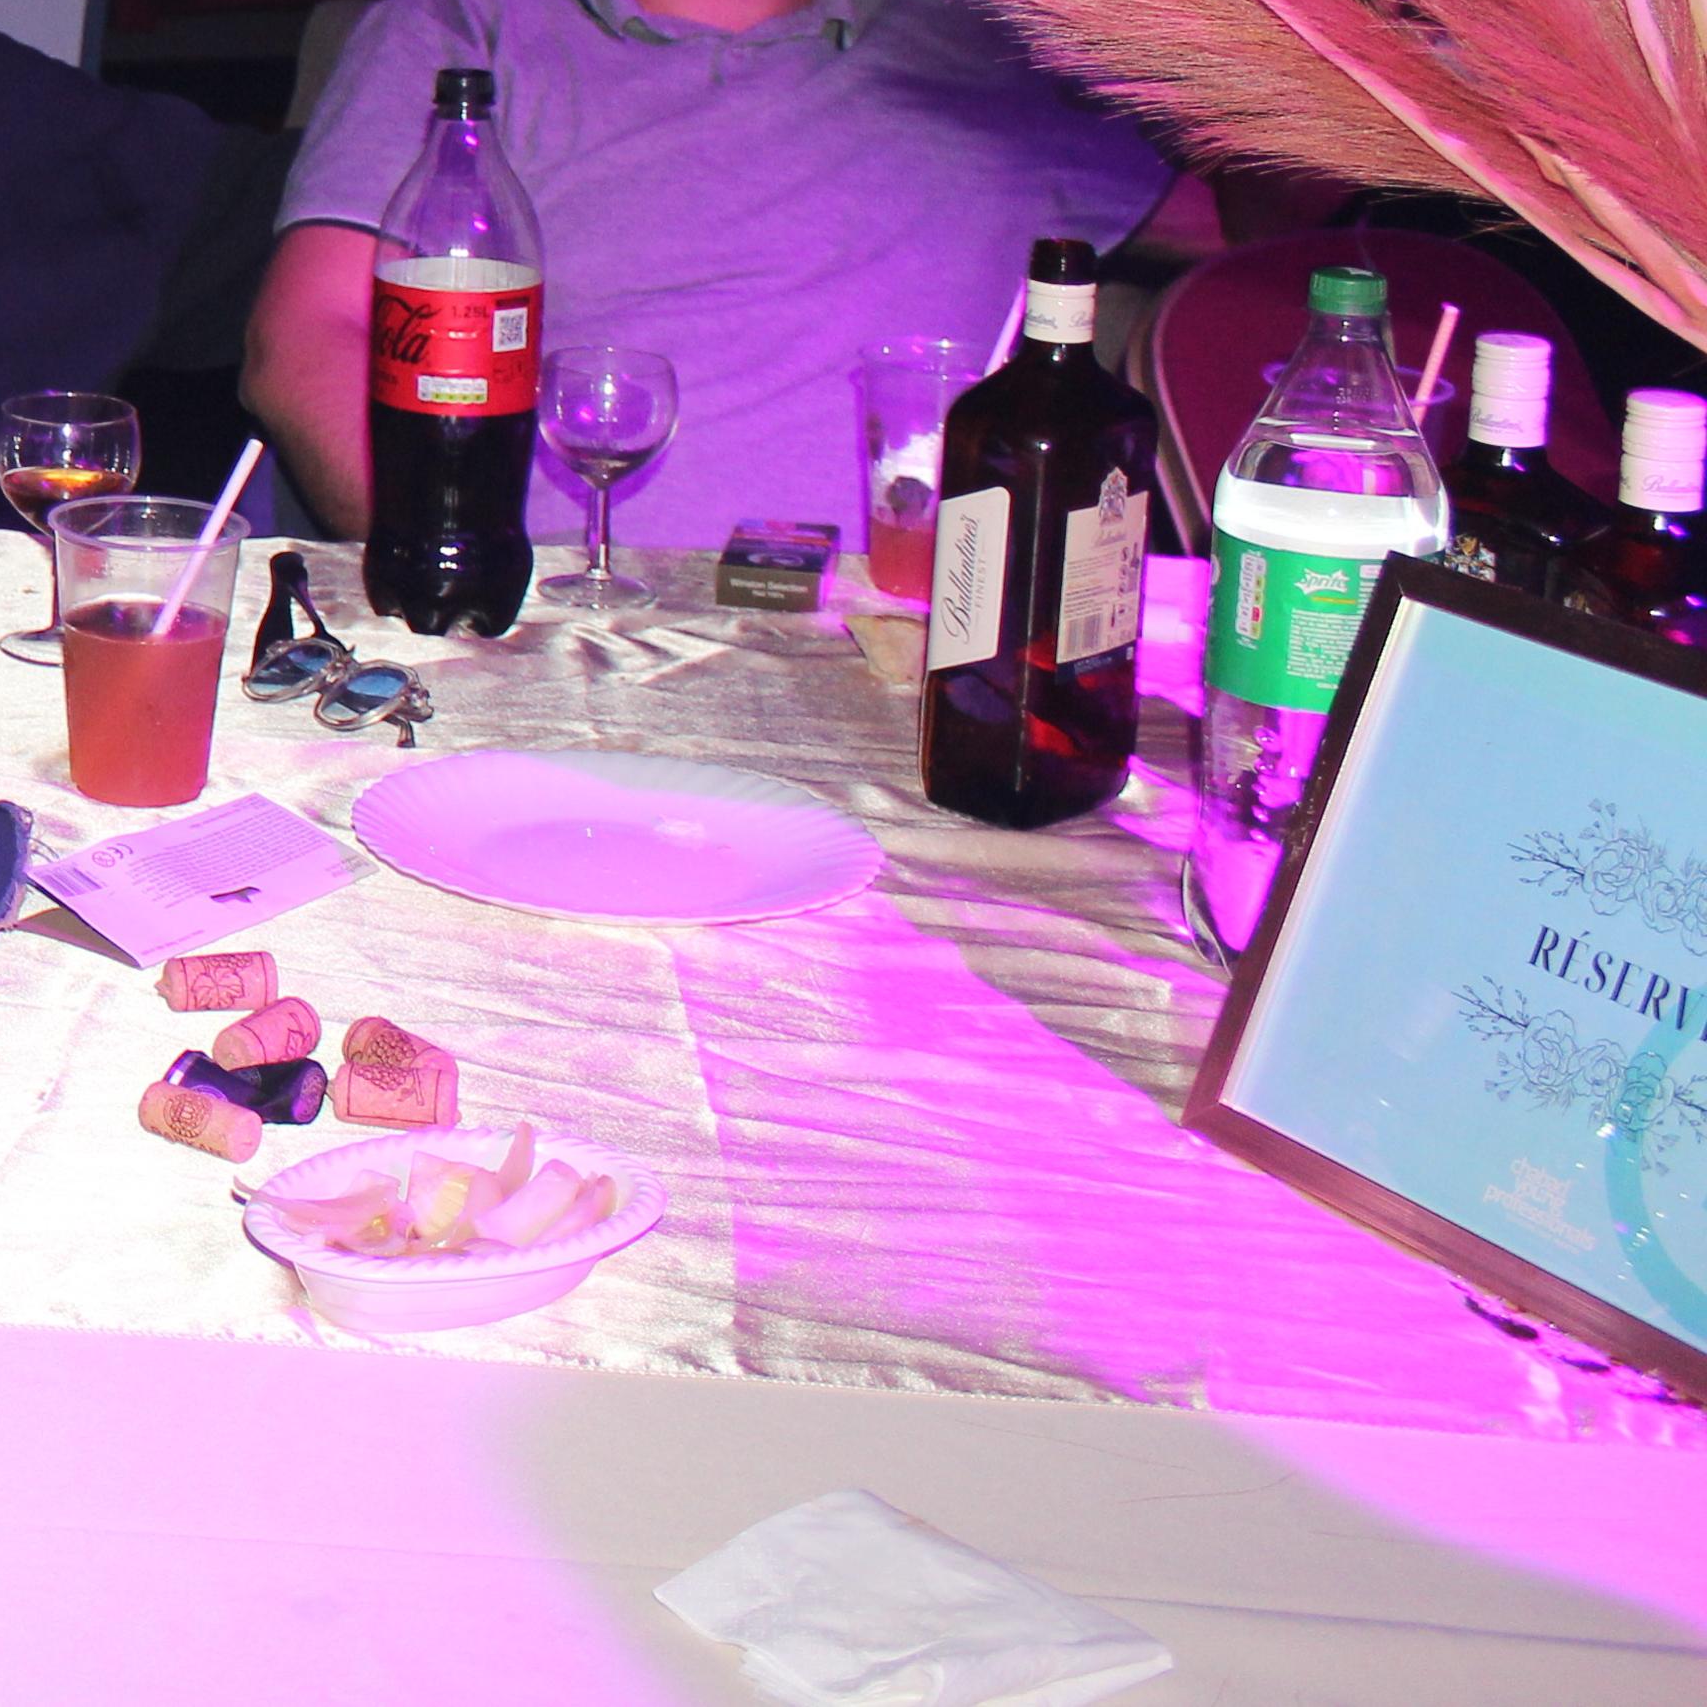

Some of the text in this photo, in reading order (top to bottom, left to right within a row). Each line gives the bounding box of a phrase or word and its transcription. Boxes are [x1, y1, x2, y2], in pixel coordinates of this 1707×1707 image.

[938, 513, 980, 646] Ballantine's
[973, 558, 987, 609] FINEST
[1300, 571, 1349, 593] Sprite
[1527, 924, 1707, 1042] RÉSERV
